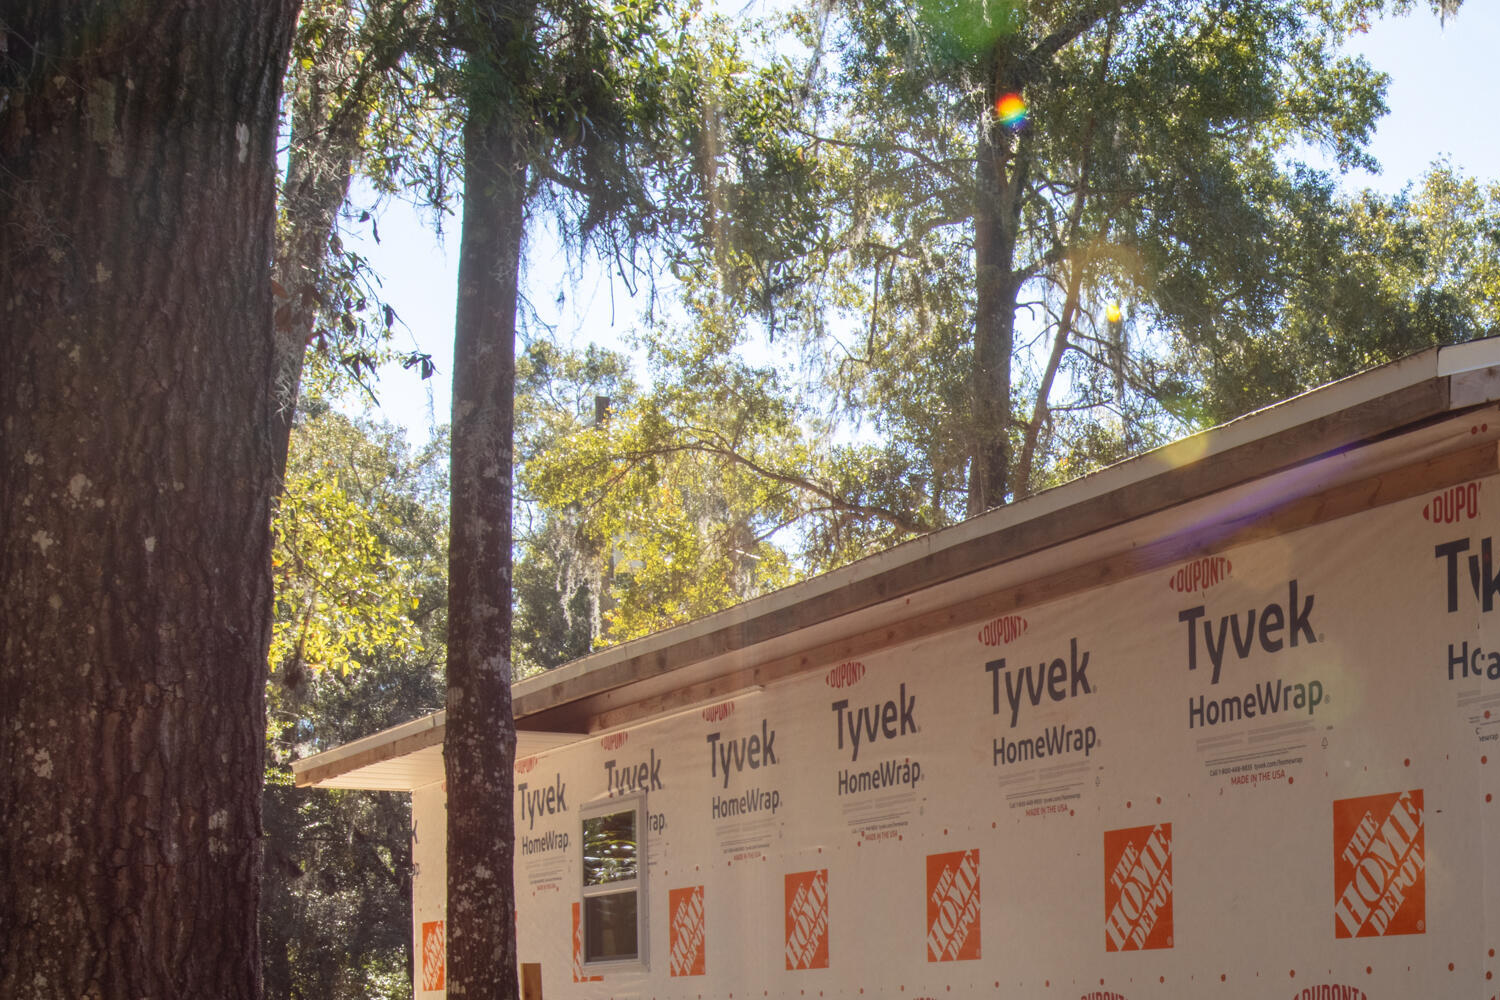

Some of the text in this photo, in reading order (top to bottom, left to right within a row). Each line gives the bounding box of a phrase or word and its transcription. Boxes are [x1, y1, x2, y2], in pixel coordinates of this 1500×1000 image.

[1433, 482, 1481, 524] DUPO
[1177, 557, 1226, 592] DUPONT
[984, 616, 1022, 646] DUPONT
[1179, 579, 1317, 685] Tyvek
[830, 662, 863, 688] DUPONT
[985, 637, 1091, 728] Tyvek
[832, 683, 917, 762] Tyvek
[1189, 679, 1323, 729] HomeWrap
[707, 719, 777, 789] Tyvek
[993, 724, 1096, 766] HomeWrap
[604, 748, 663, 796] Tyvek
[838, 759, 921, 796] HomeWrap
[1231, 775, 1249, 784] MADE
[1259, 771, 1270, 782] THE
[1272, 769, 1285, 779] USA
[518, 773, 567, 830] Tyvek
[712, 788, 780, 820] HomeWrap
[522, 830, 569, 856] HomeWrap
[1341, 810, 1379, 868] THE
[932, 864, 953, 907] THE
[1105, 824, 1172, 951] HOME
[1110, 840, 1139, 890] THE
[1335, 791, 1424, 938] HOME
[1369, 843, 1425, 936] DEPOT
[927, 850, 980, 962] HOME
[948, 891, 981, 960] DEPOT
[1131, 869, 1173, 950] DEPOT
